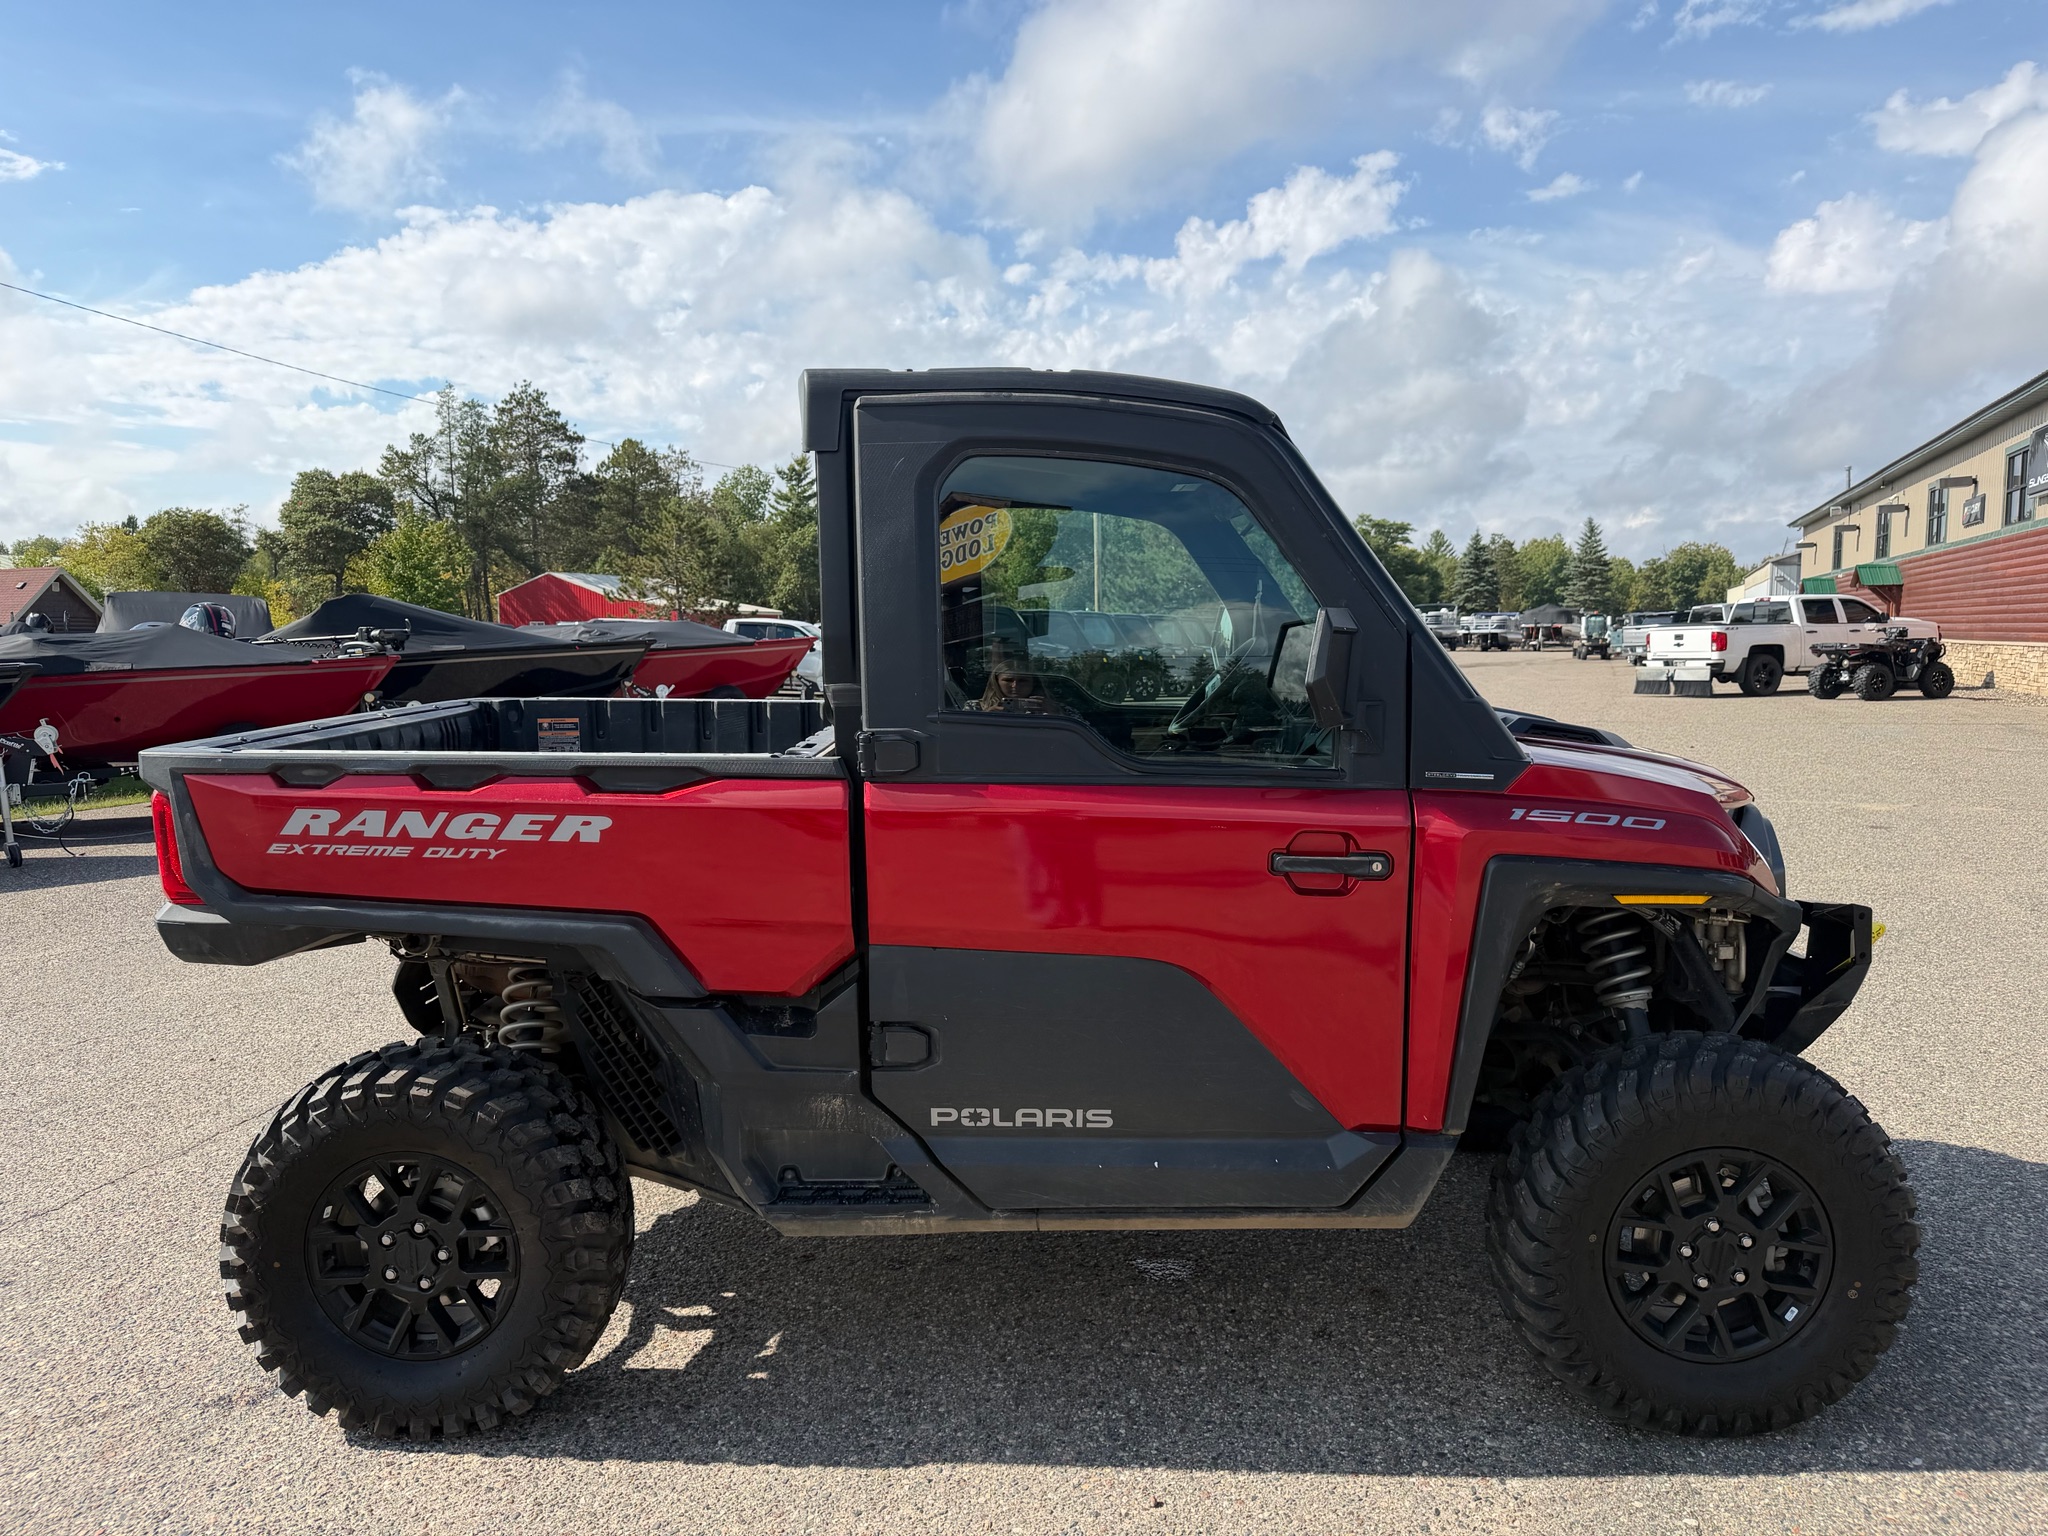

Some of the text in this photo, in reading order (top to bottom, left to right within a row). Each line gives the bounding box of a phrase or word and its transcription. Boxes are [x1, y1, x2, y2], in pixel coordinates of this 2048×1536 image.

[279, 808, 613, 843] RANGER
[1509, 808, 1667, 831] 1500
[266, 843, 507, 860] EXTREME DUTY
[930, 1107, 1114, 1128] POLARIS
